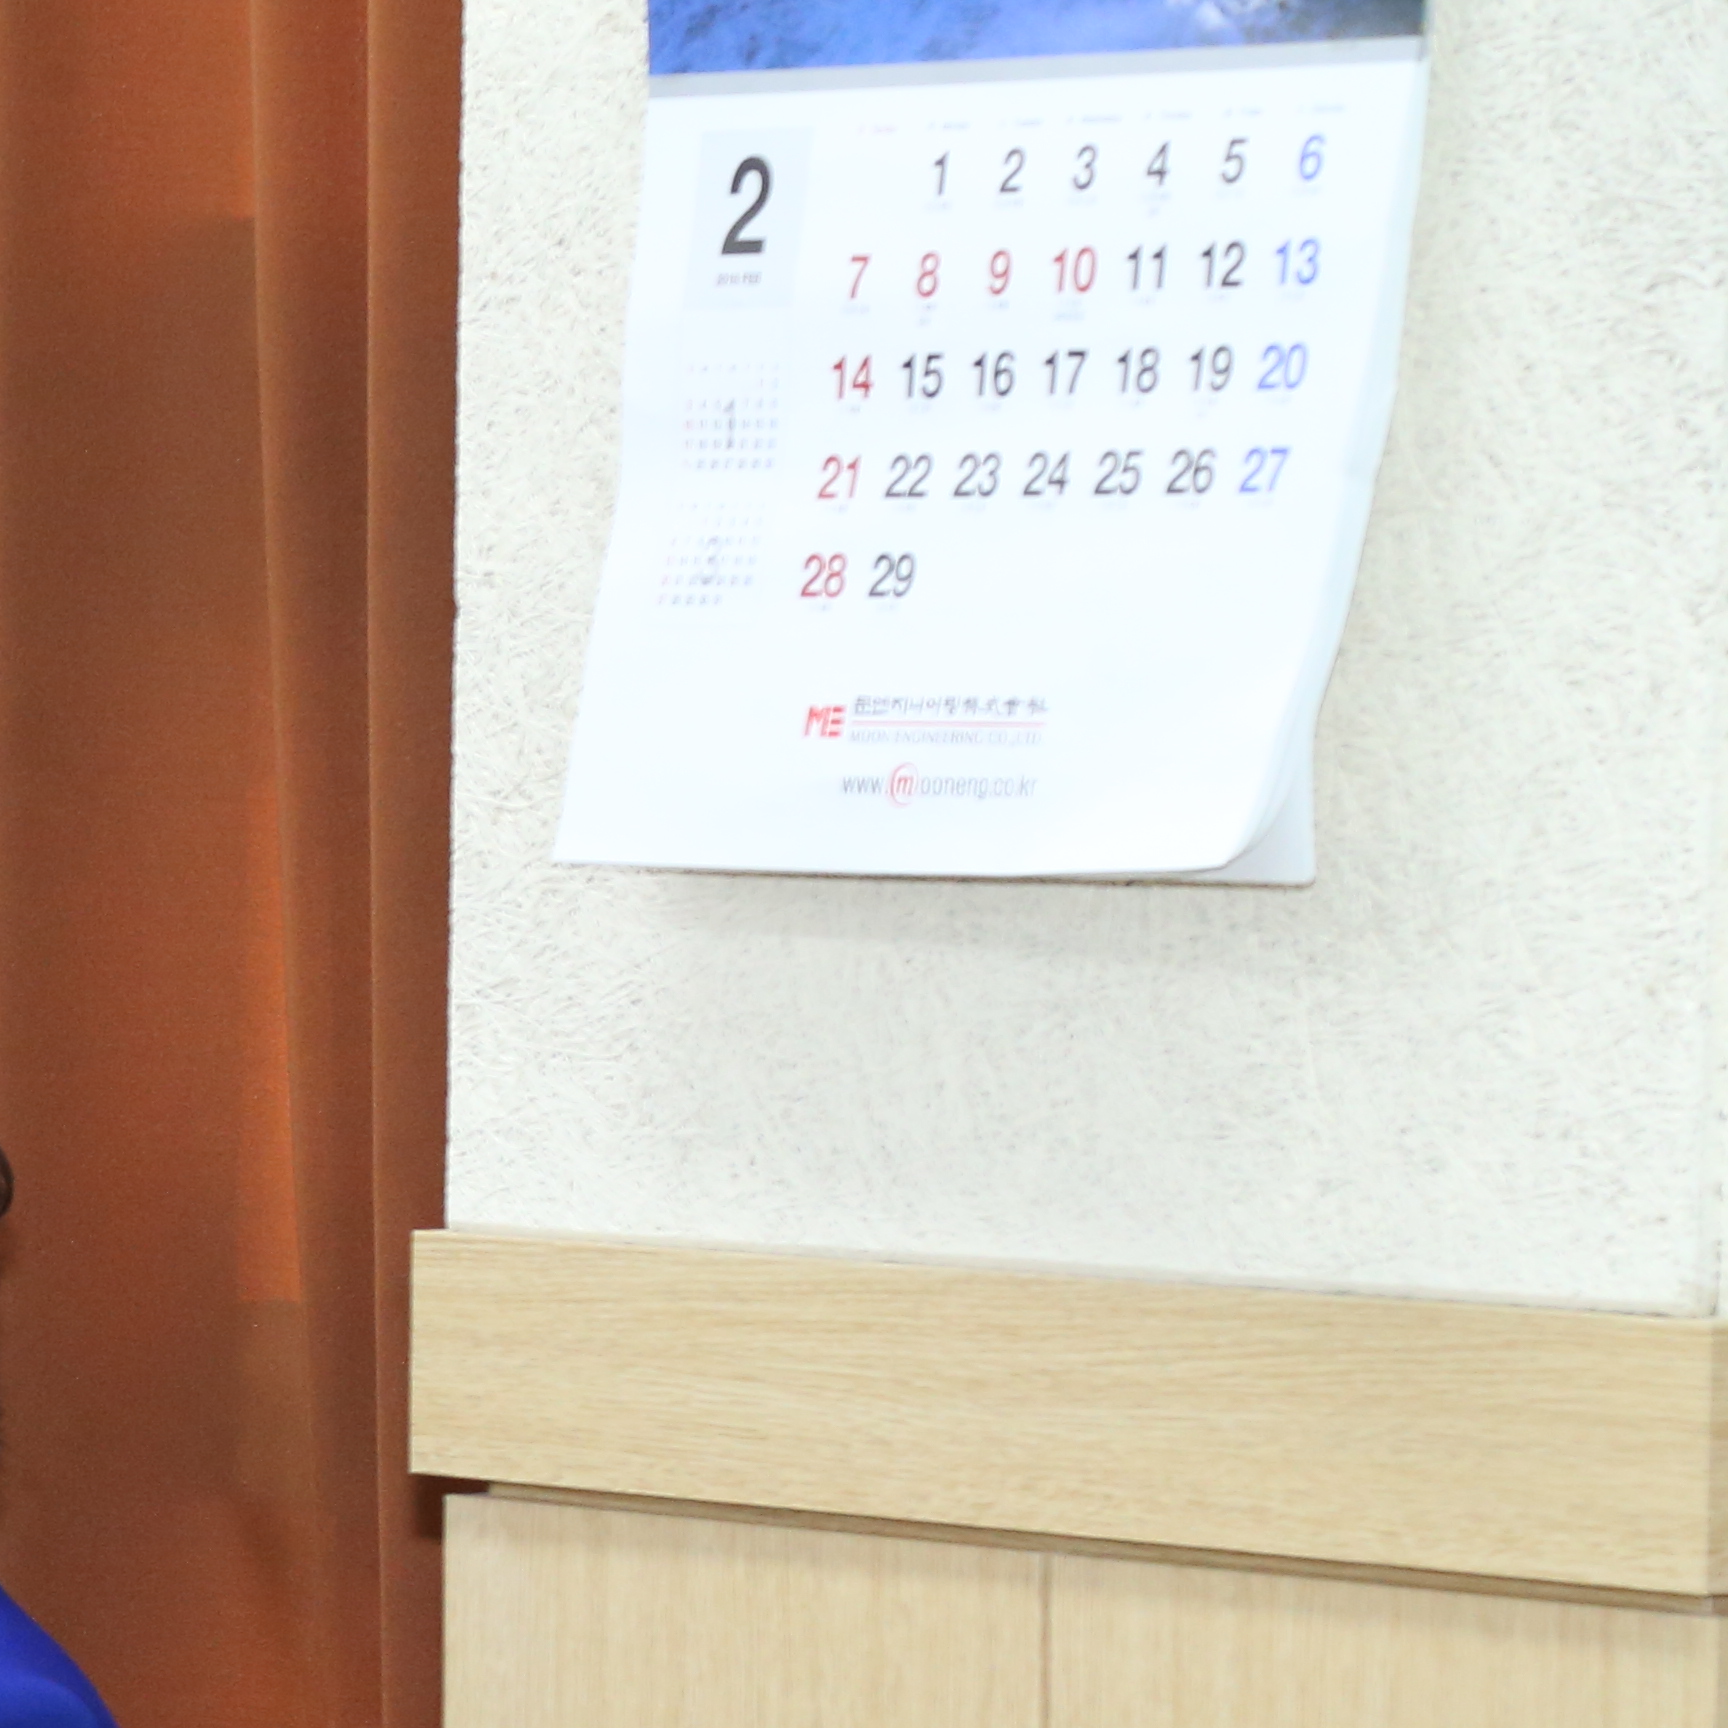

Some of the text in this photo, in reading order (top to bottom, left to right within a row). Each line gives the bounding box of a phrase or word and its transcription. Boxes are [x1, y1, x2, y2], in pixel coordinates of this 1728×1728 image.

[932, 131, 1328, 198] 1 2 3 4 5 6
[720, 155, 773, 256] 2
[848, 235, 1323, 301] 7 8 9 10 11 12 13
[832, 341, 1310, 400] 14 15 16 17 18 19 20
[817, 445, 1292, 500] 21 22 23 24 25 26 27
[799, 552, 917, 599] 28 29
[804, 705, 846, 738] ME
